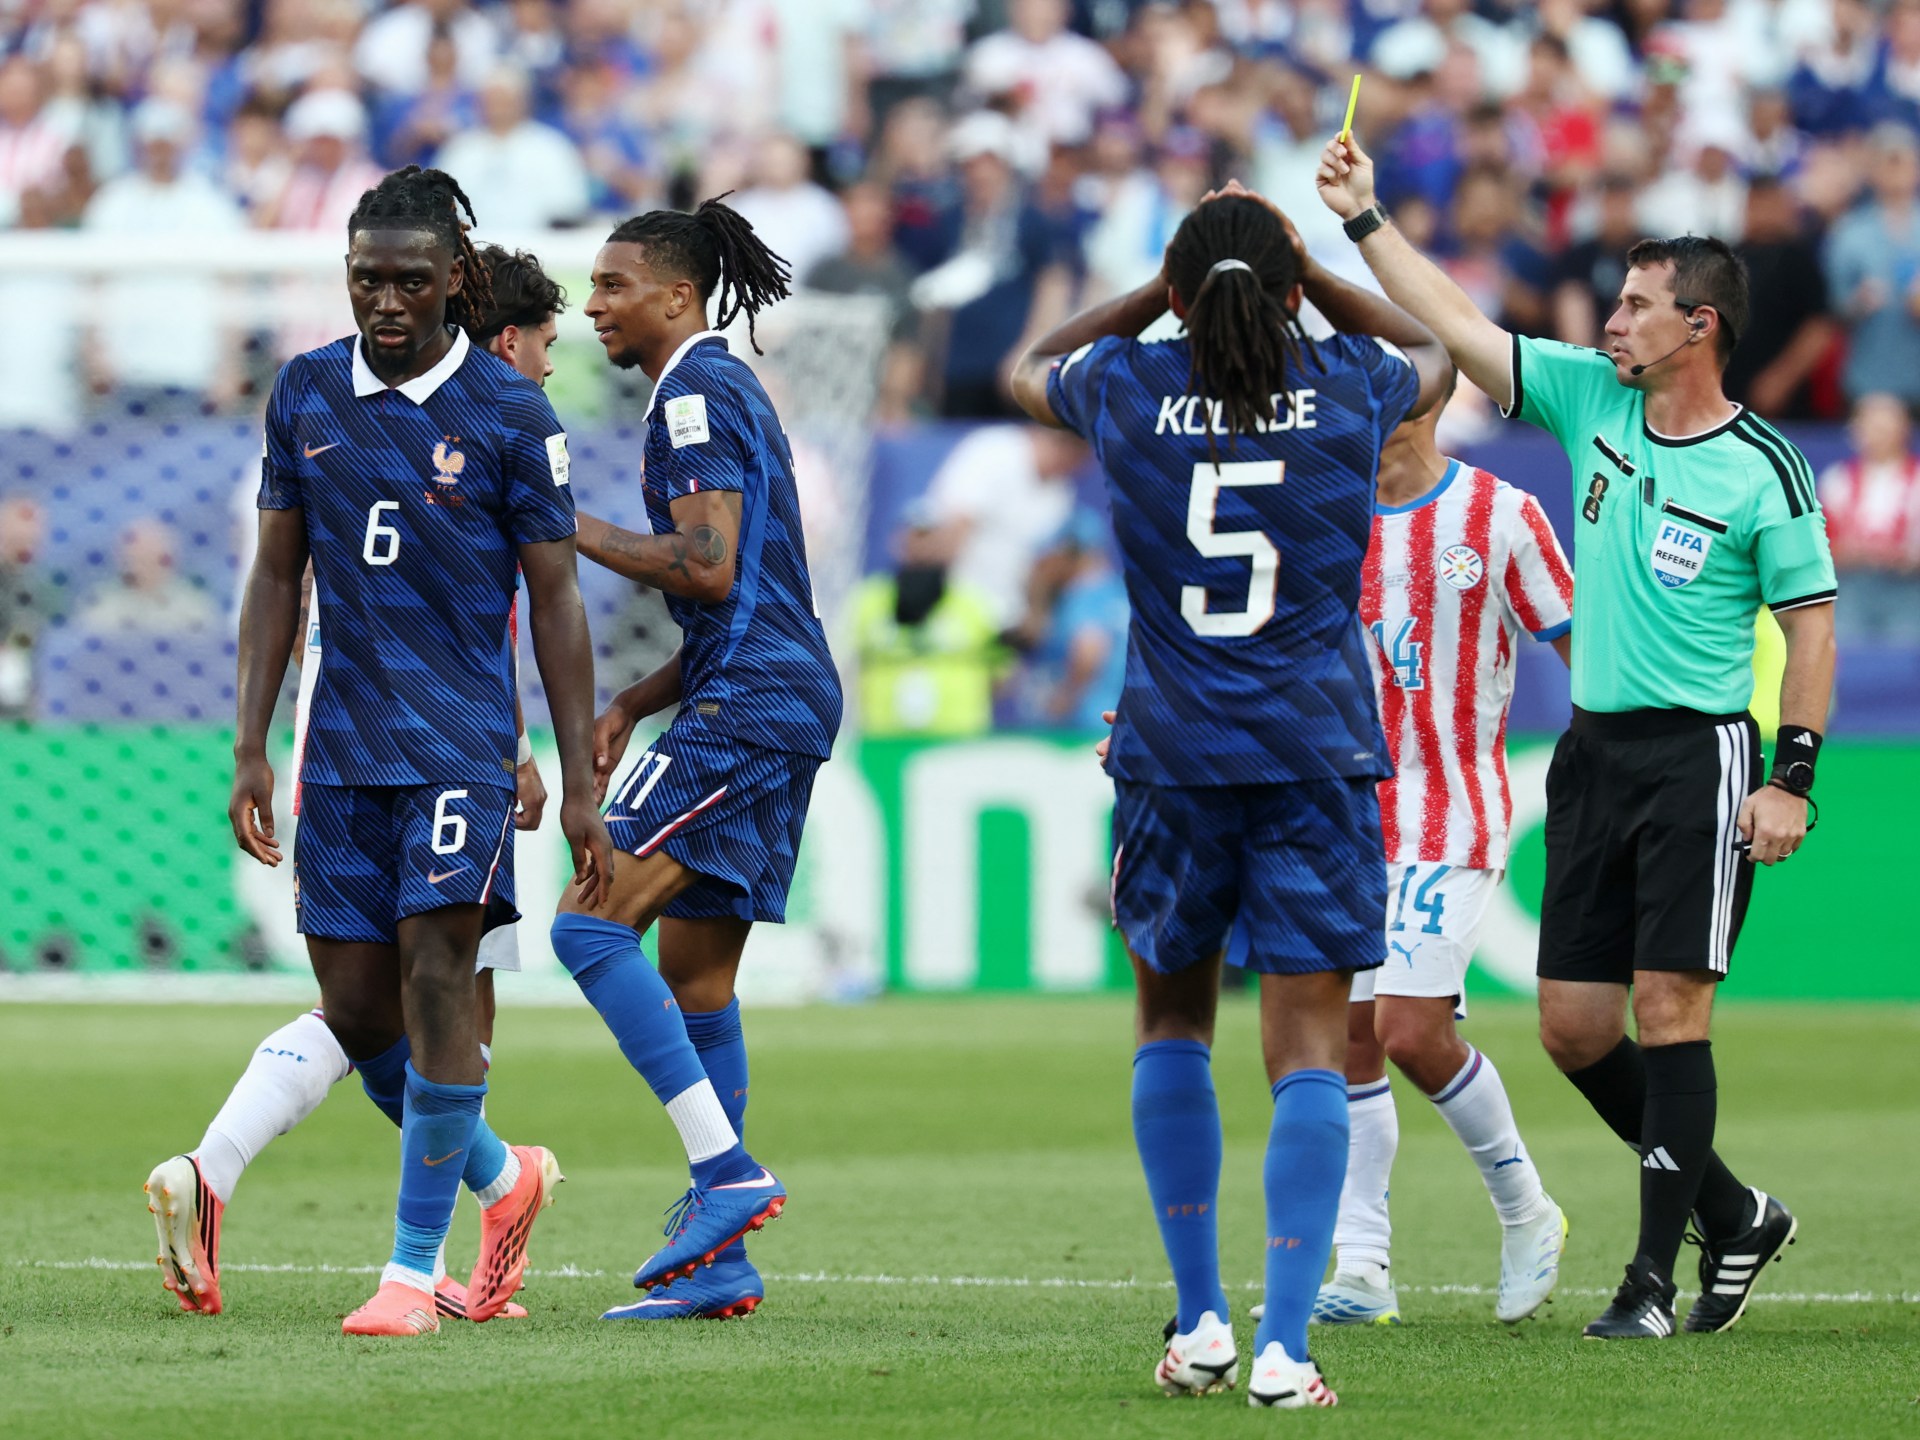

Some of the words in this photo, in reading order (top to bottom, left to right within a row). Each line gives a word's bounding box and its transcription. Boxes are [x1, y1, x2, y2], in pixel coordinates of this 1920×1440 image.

[362, 500, 400, 566] 6
[1180, 460, 1285, 637] 5
[1453, 548, 1468, 556] APF
[1655, 549, 1698, 570] REFEREE
[1662, 525, 1703, 553] FIFA
[1660, 572, 1680, 586] 2026
[1369, 616, 1425, 691] 14
[614, 751, 673, 811] 11
[431, 789, 468, 855] 6
[1389, 864, 1452, 935] 14
